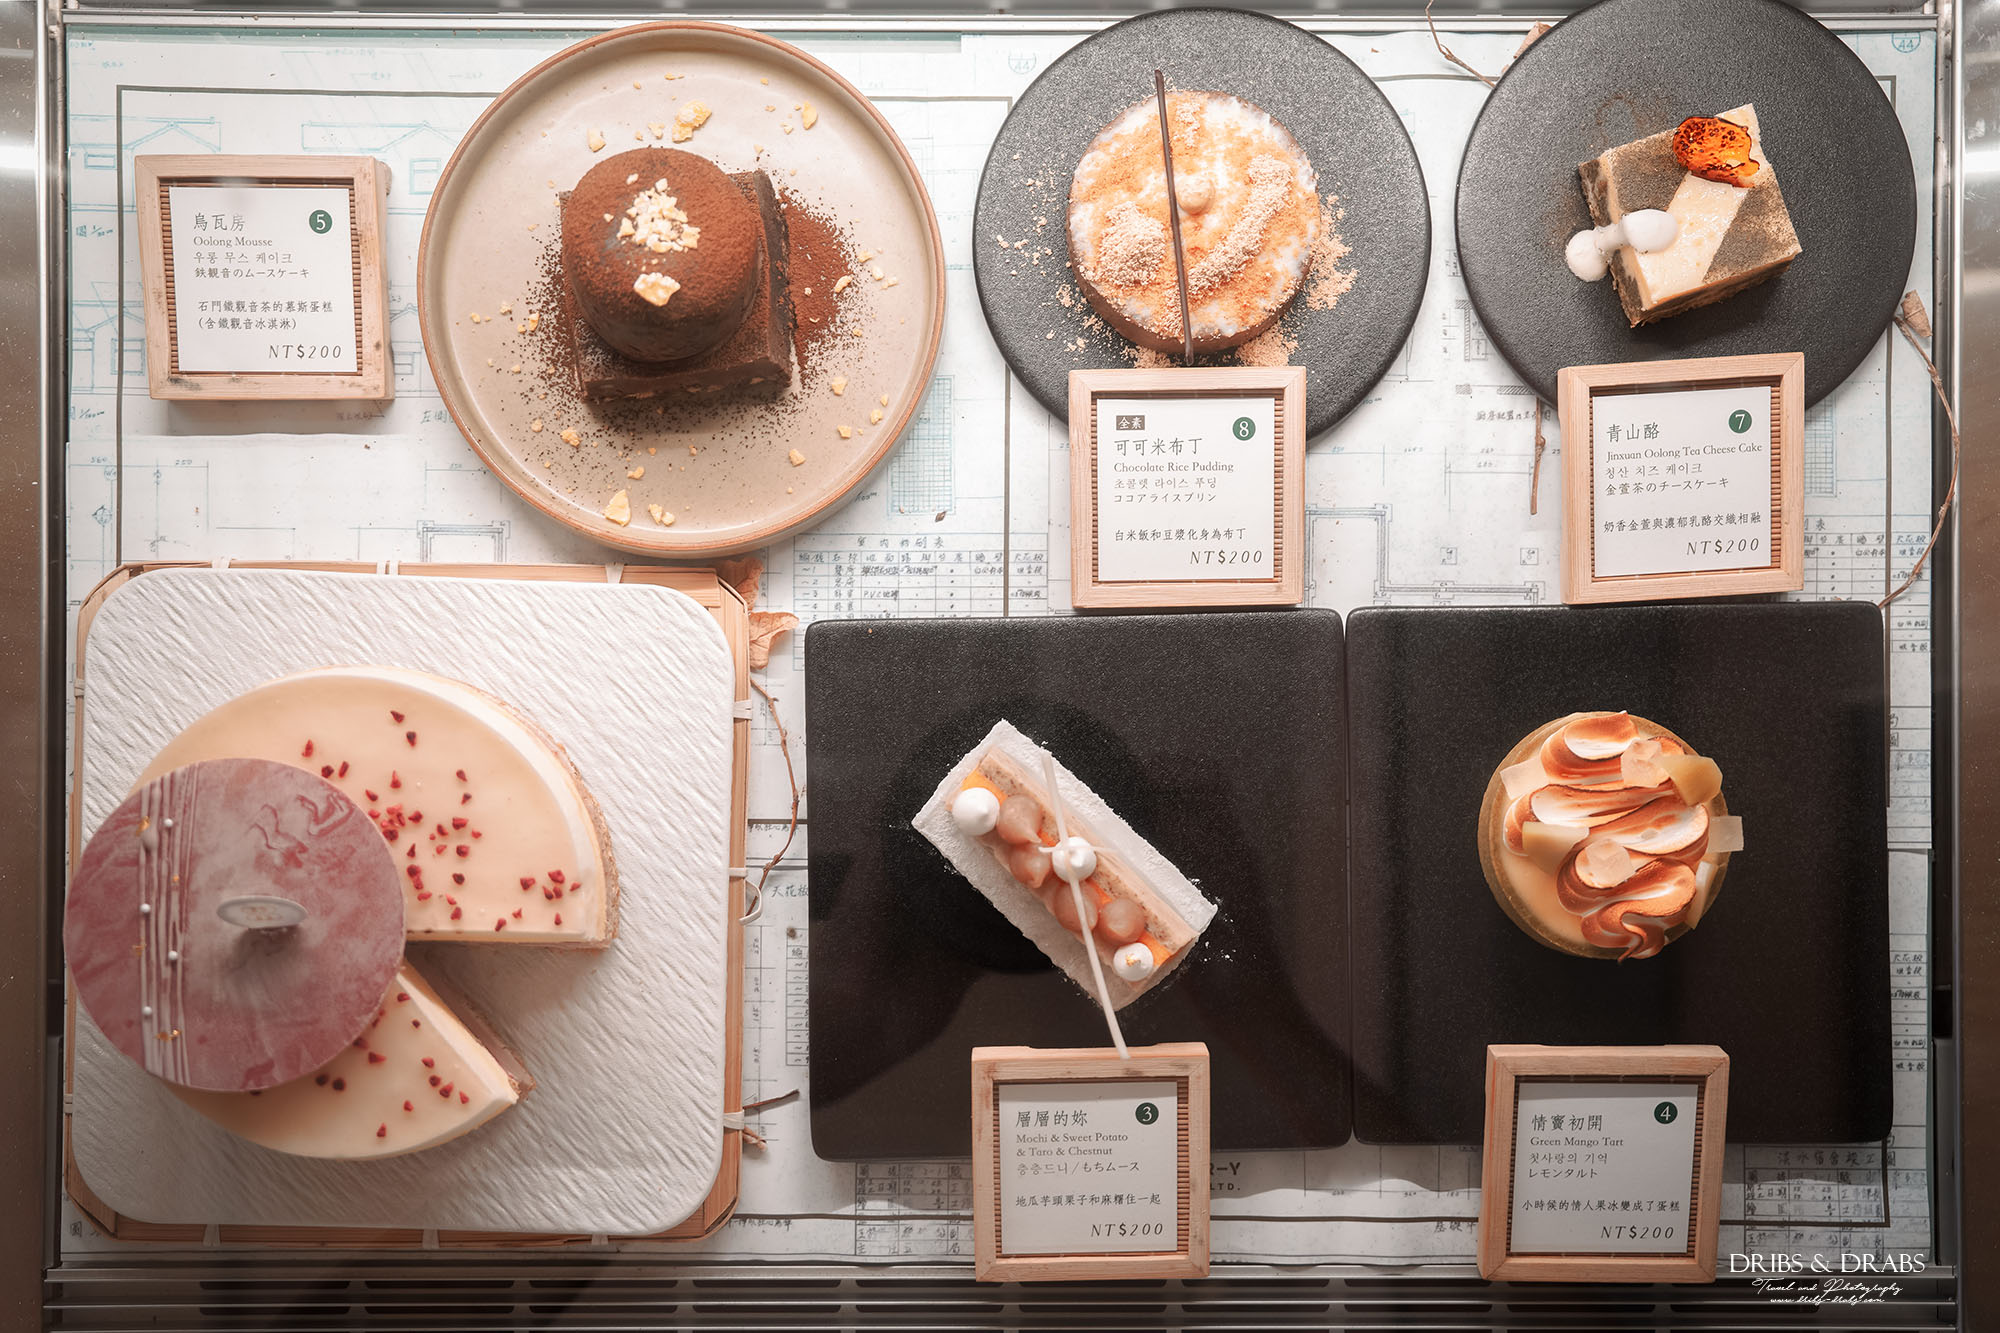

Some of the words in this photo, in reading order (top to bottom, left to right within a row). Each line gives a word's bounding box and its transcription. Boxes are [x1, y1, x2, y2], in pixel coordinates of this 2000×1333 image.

[315, 213, 326, 231] 5
[193, 236, 232, 248] Oolong
[235, 236, 273, 247] Mousse
[193, 251, 218, 265] 우롱
[224, 251, 249, 264] 무스
[256, 251, 293, 264] 케이크
[268, 344, 342, 359] NT$200
[1118, 416, 1143, 430] 全素
[1238, 420, 1250, 438] 8
[1734, 413, 1746, 430] 7
[1606, 421, 1660, 443] 青山酪
[1114, 437, 1203, 456] 可可米布丁
[1606, 451, 1642, 463] Jinxuan
[1644, 447, 1680, 459] Oolong
[1682, 446, 1701, 457] Tea
[1703, 443, 1736, 455] Cheese
[1738, 442, 1763, 453] Cake
[1114, 462, 1165, 472] Chocolate
[1167, 462, 1190, 472] Rice
[1192, 461, 1234, 473] Pudding
[1635, 464, 1660, 477] 치즈
[1665, 462, 1703, 476] 케이크
[1154, 477, 1189, 489] 라이스
[1194, 476, 1217, 489] 푸딩
[1686, 537, 1760, 556] NT$200
[1189, 549, 1262, 565] NT$200
[1015, 1109, 1088, 1128] 層層的妳
[1141, 1105, 1153, 1122] 3
[1659, 1105, 1671, 1121] 4
[1016, 1133, 1048, 1143] Mochi
[1050, 1133, 1061, 1143] &
[1063, 1132, 1092, 1143] Sweet
[1095, 1132, 1128, 1142] Potato
[1530, 1136, 1561, 1146] Green
[1564, 1136, 1599, 1147] Mango
[1602, 1136, 1624, 1146] Tart
[1016, 1147, 1026, 1157] &
[1028, 1147, 1053, 1157] Taro
[1055, 1147, 1066, 1156] &
[1068, 1146, 1113, 1156] Chestnut
[1584, 1152, 1608, 1165] 기억
[1529, 1168, 1599, 1178] レモンタルト
[1090, 1222, 1164, 1237] NT$200
[1600, 1225, 1674, 1240] NT$200
